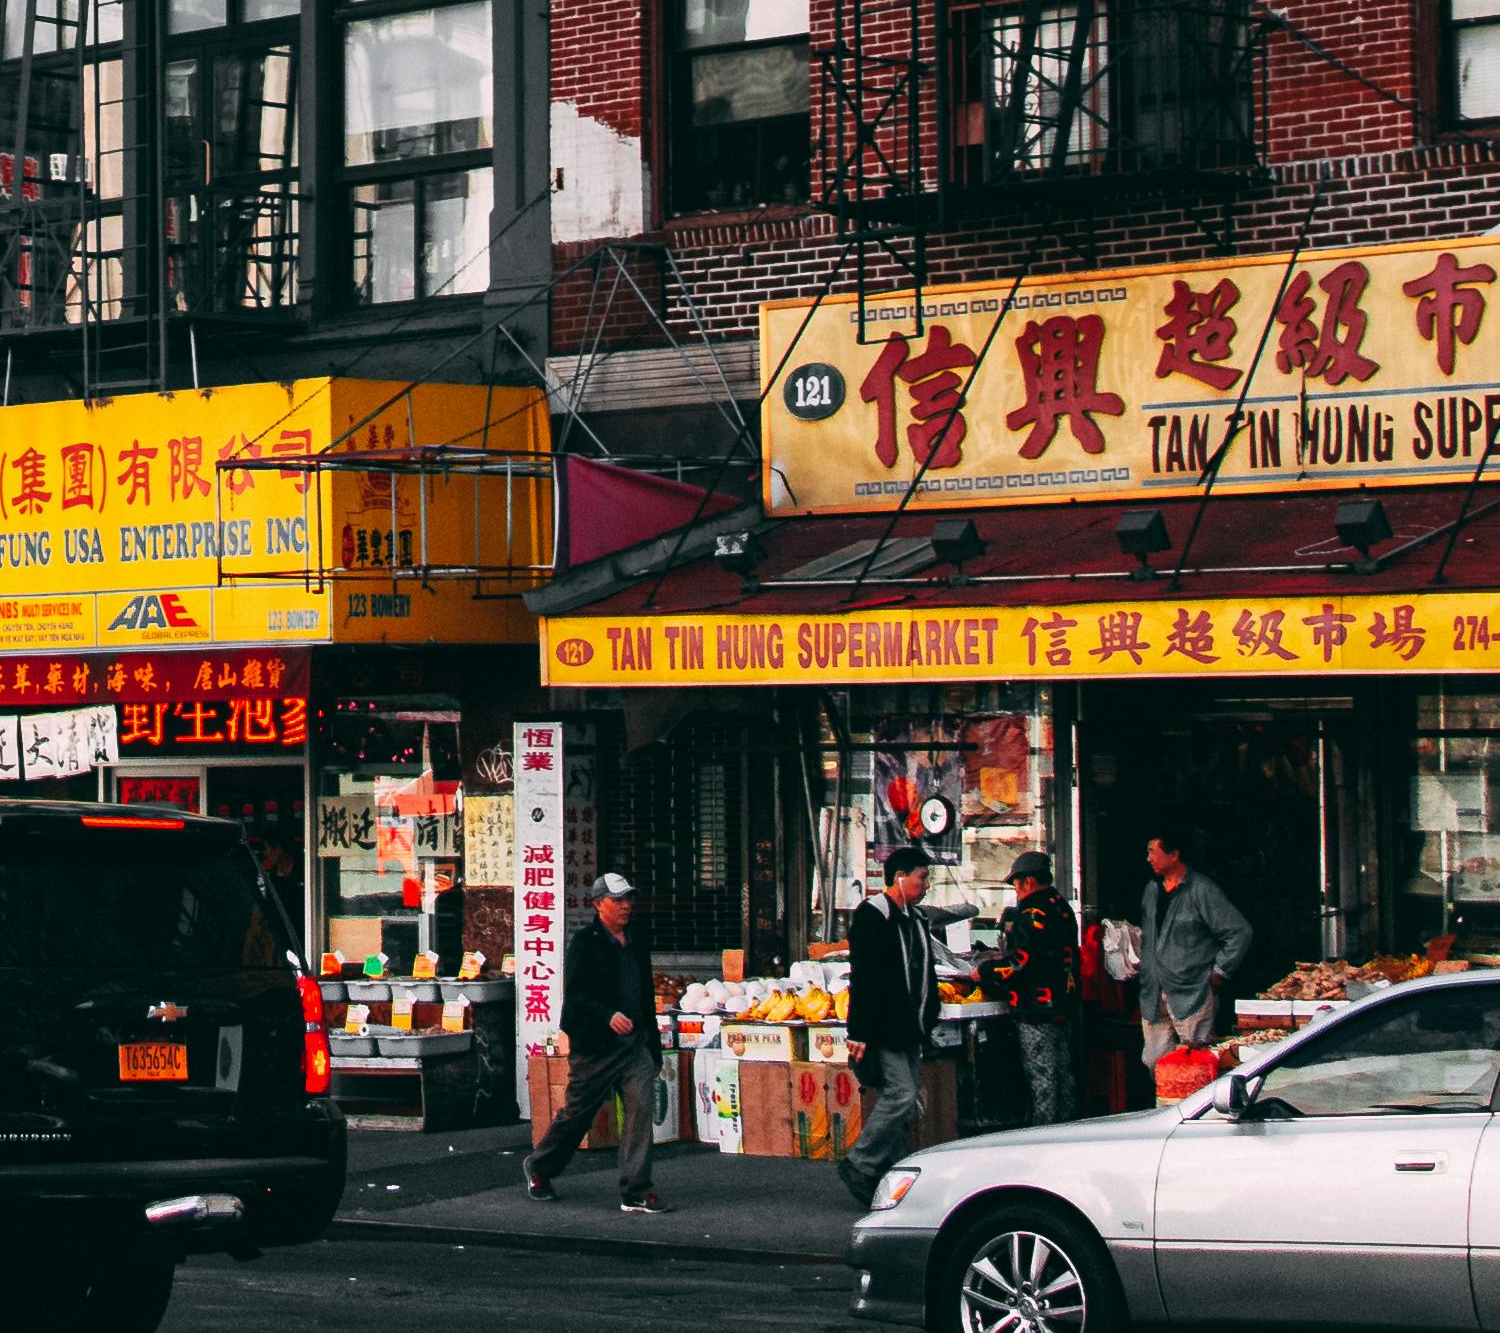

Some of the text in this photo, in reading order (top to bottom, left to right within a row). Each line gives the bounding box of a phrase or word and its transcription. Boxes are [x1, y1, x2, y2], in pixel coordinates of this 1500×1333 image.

[795, 374, 832, 407] 121
[1148, 413, 1210, 473] TAN
[64, 527, 105, 565] USA
[119, 519, 253, 562] ENTERPRISE
[563, 640, 587, 662] 121
[606, 617, 999, 671] TAN TIN HUNG SUPERMARKET
